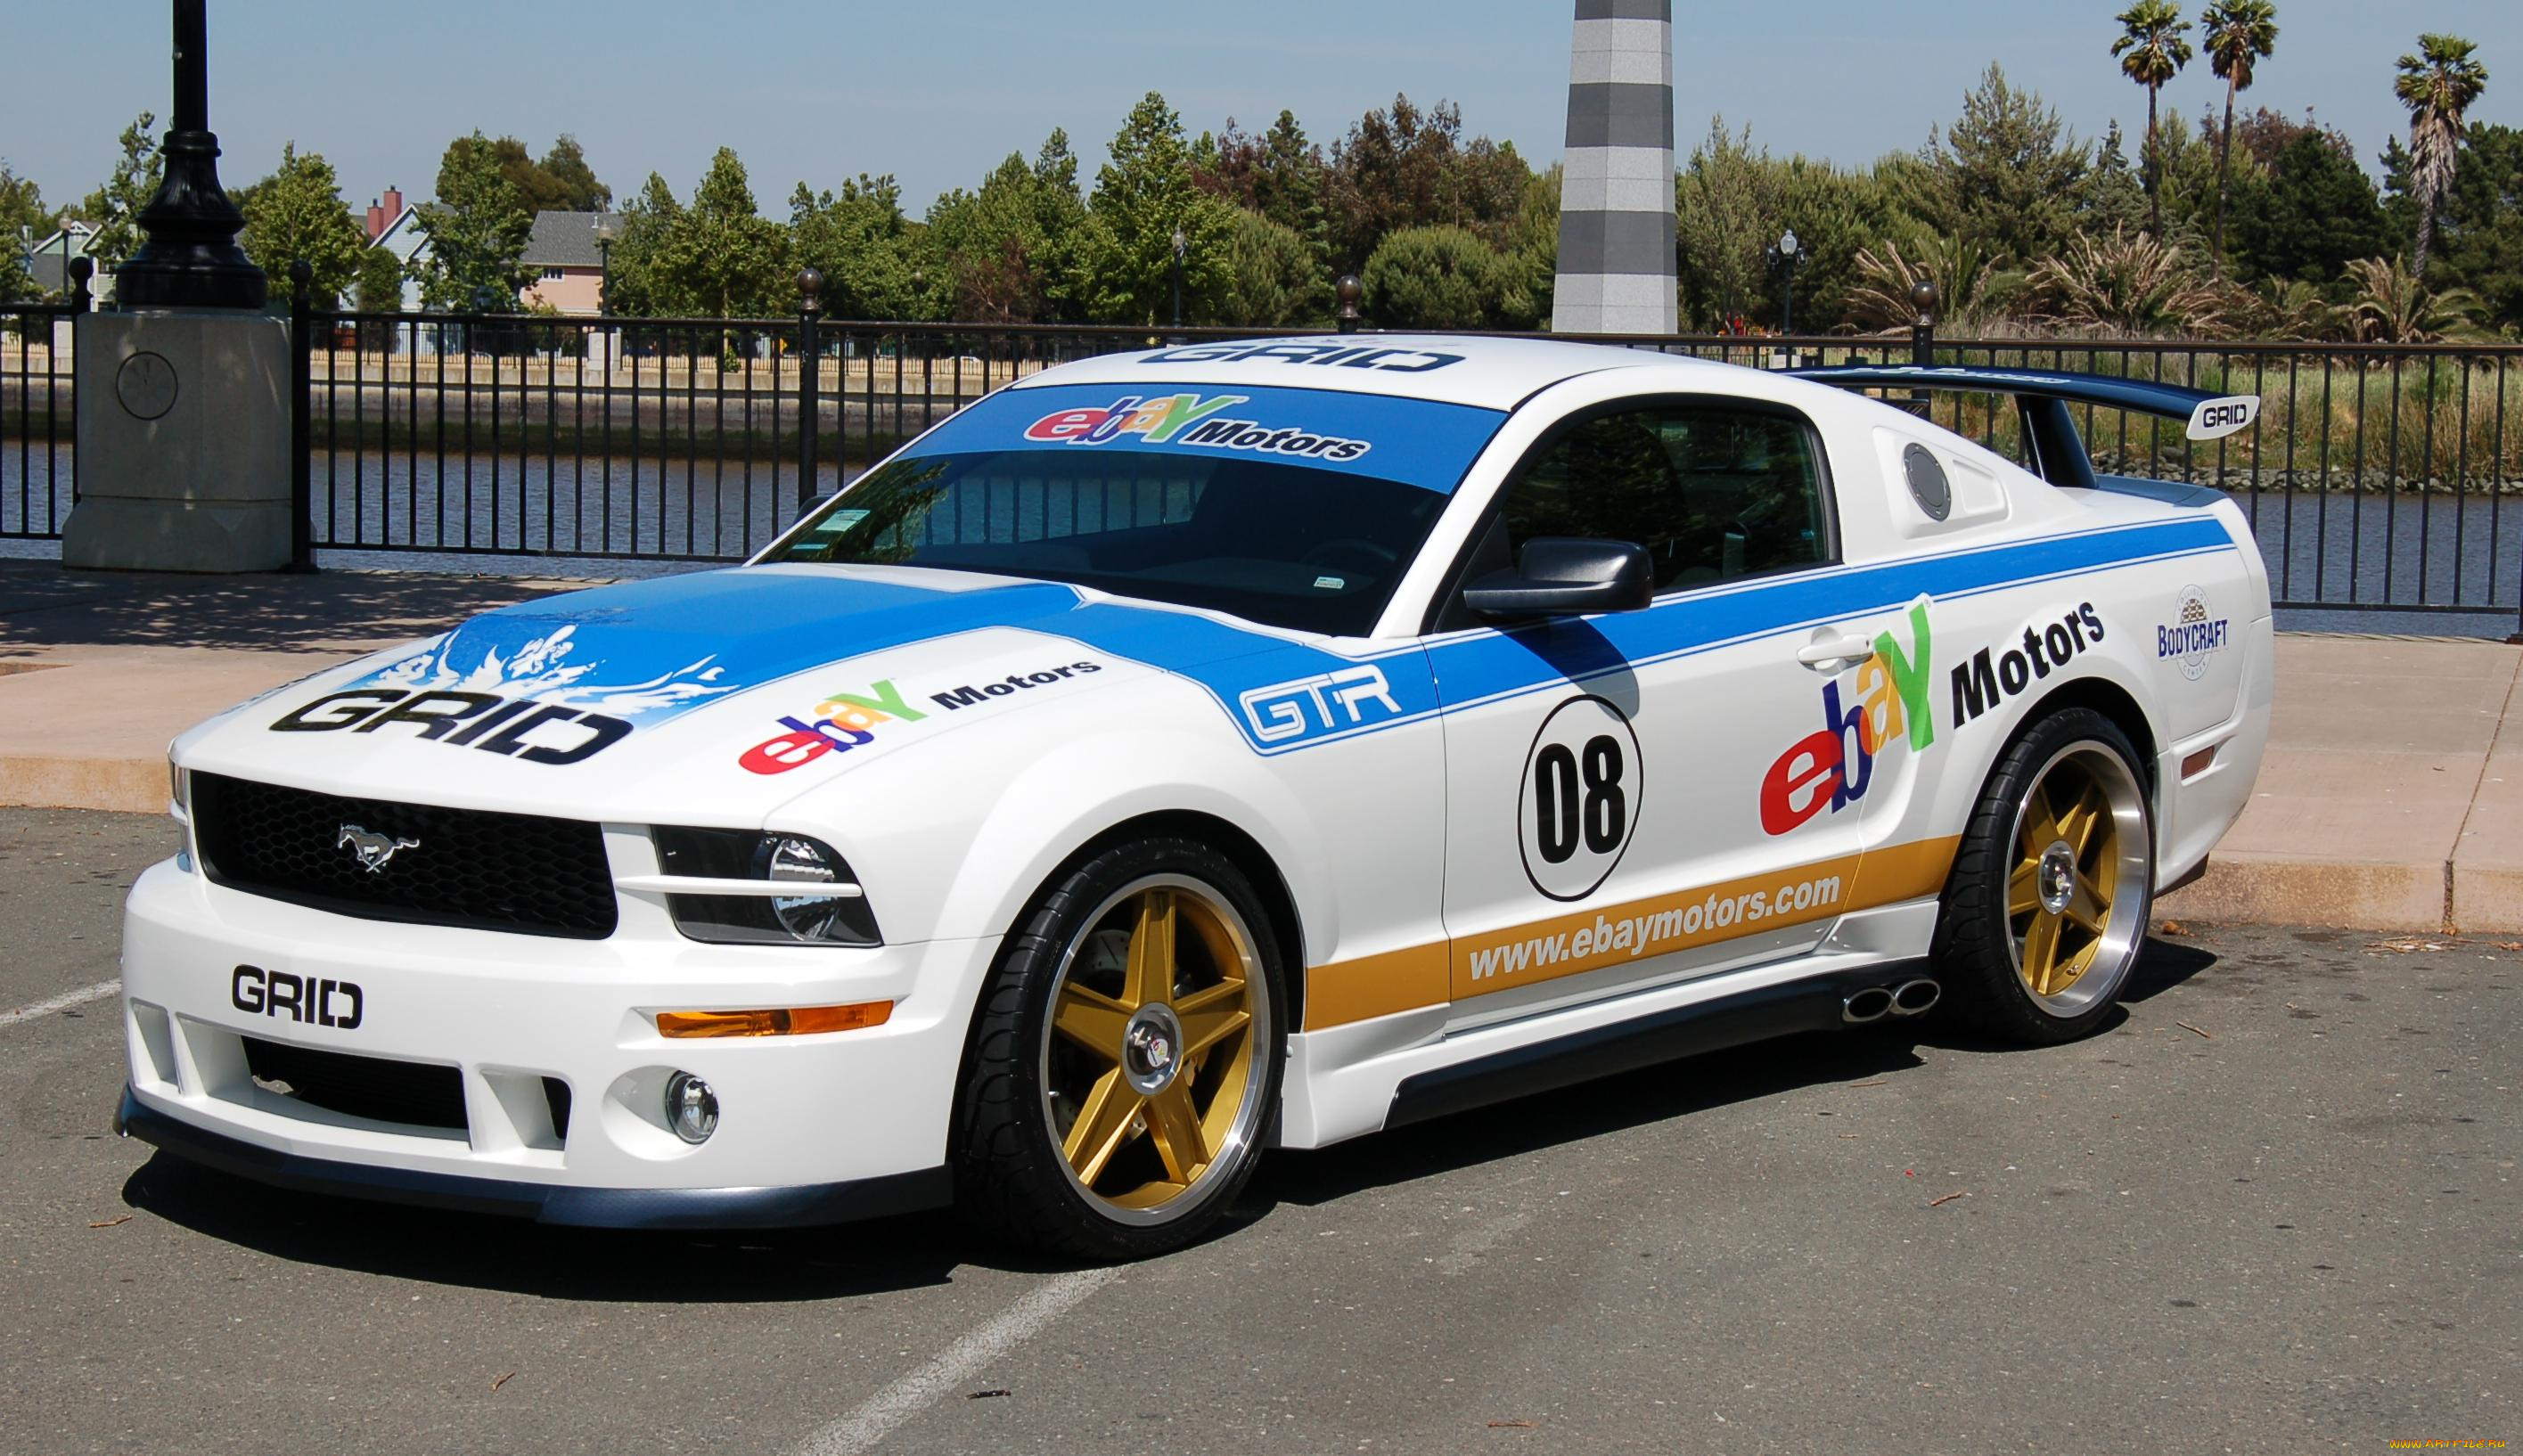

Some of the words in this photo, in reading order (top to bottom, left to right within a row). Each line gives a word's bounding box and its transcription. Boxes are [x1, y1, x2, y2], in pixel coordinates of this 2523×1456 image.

[1137, 345, 1466, 372] GRID
[1187, 421, 1370, 459] Motors
[2203, 404, 2247, 428] GRID
[930, 661, 1102, 710] Motors
[1951, 601, 2105, 730] Motors
[269, 689, 634, 765] GRID
[1535, 734, 1626, 864] 08
[1469, 875, 1840, 980] www.ebaymotors.com
[232, 963, 364, 1029] GRID
